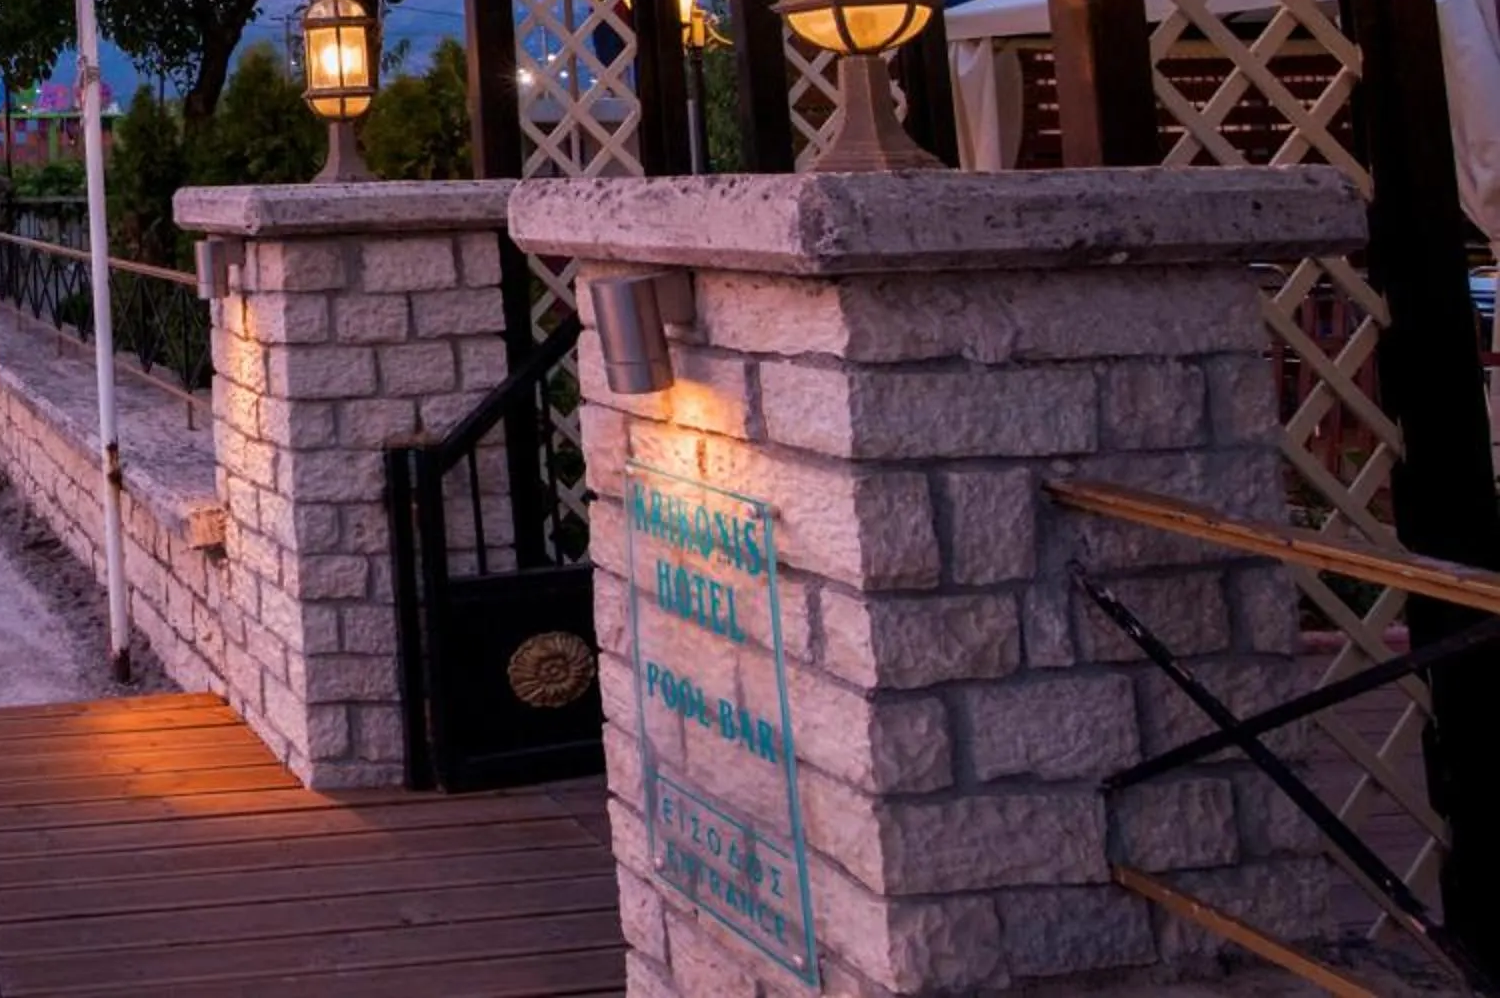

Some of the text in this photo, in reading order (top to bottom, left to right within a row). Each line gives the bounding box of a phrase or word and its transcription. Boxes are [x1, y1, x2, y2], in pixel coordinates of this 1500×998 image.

[656, 558, 747, 644] HOTEL
[646, 661, 779, 764] POOL BAR
[661, 797, 784, 899] ΕΙΣΟΔΟΣ
[664, 841, 790, 945] ENTRANCE
